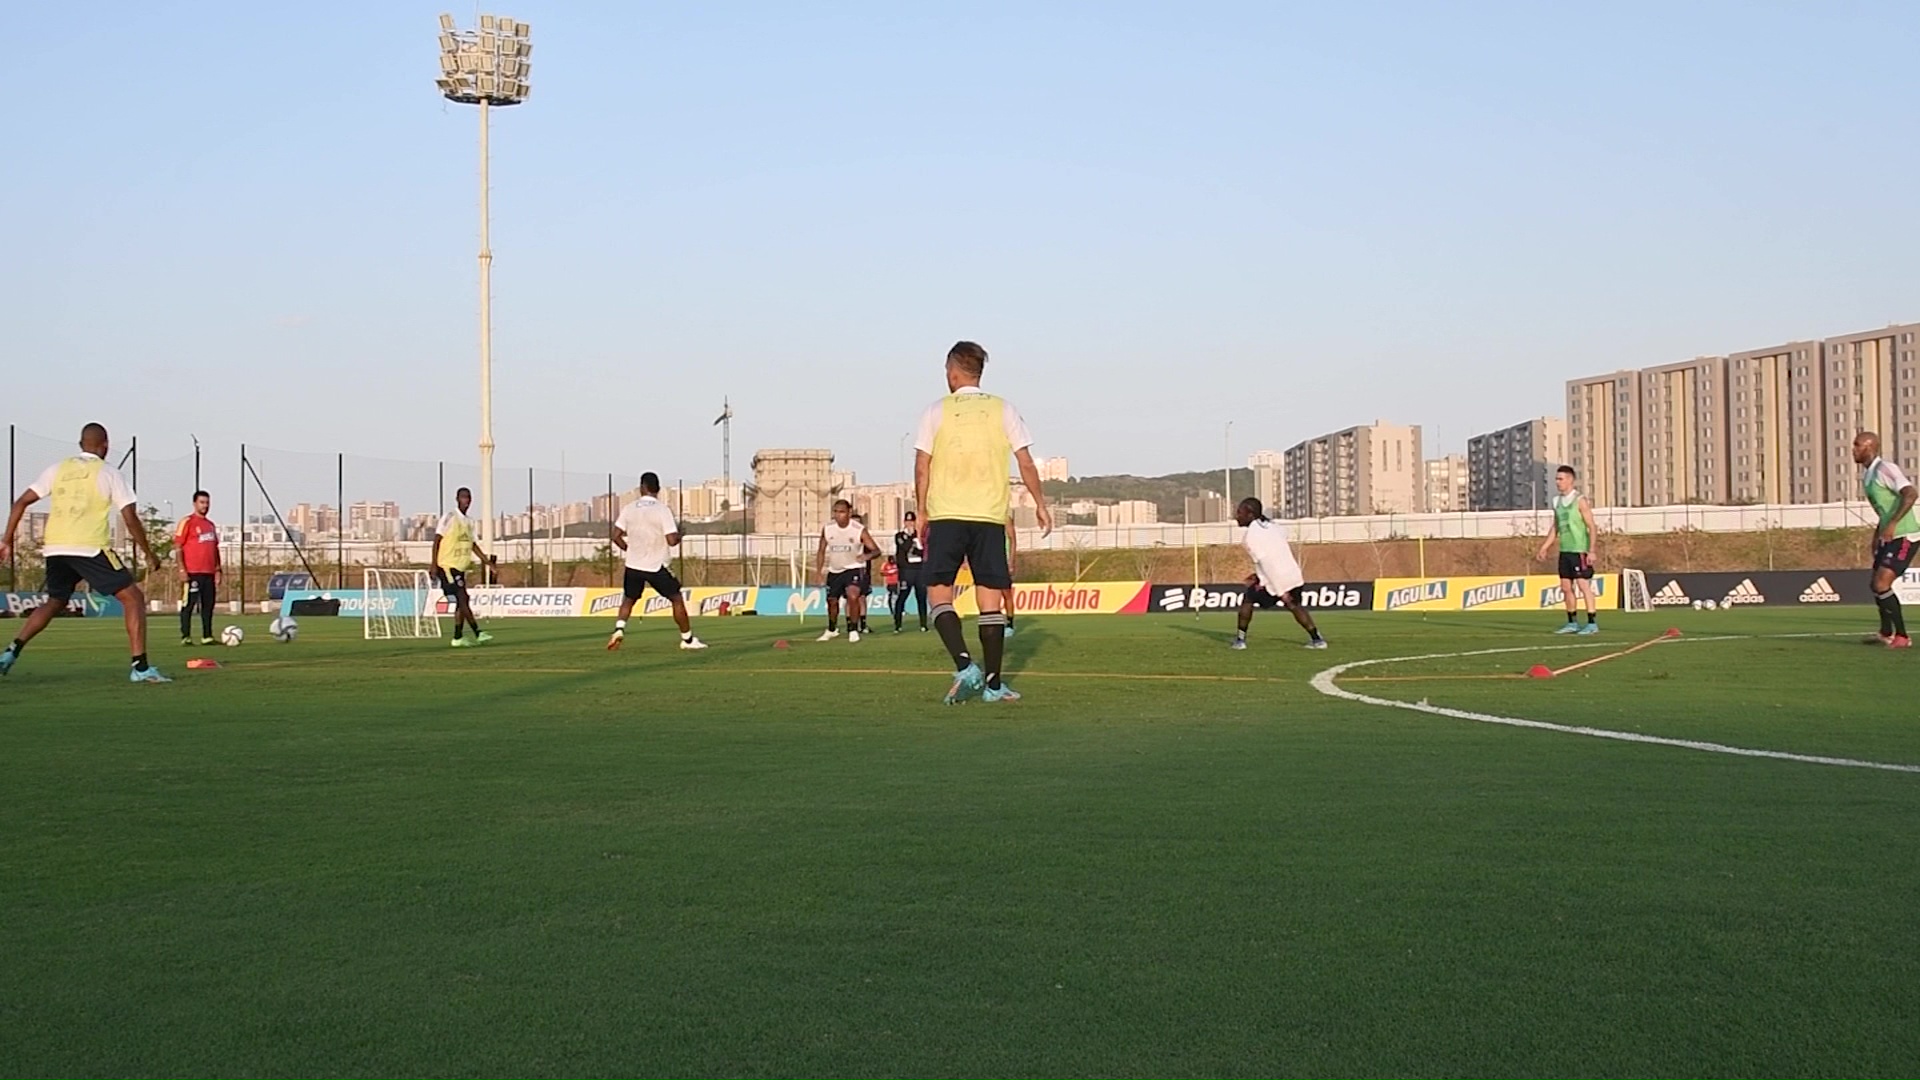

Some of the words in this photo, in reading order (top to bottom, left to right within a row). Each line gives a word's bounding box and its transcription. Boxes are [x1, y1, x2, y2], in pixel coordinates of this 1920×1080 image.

[1387, 580, 1445, 608] AGUILA
[1464, 579, 1524, 607] AGUILA
[1799, 593, 1840, 602] adidas
[469, 593, 573, 606] HOMECENTER
[1651, 596, 1690, 605] adidas
[1724, 595, 1764, 604] adidas
